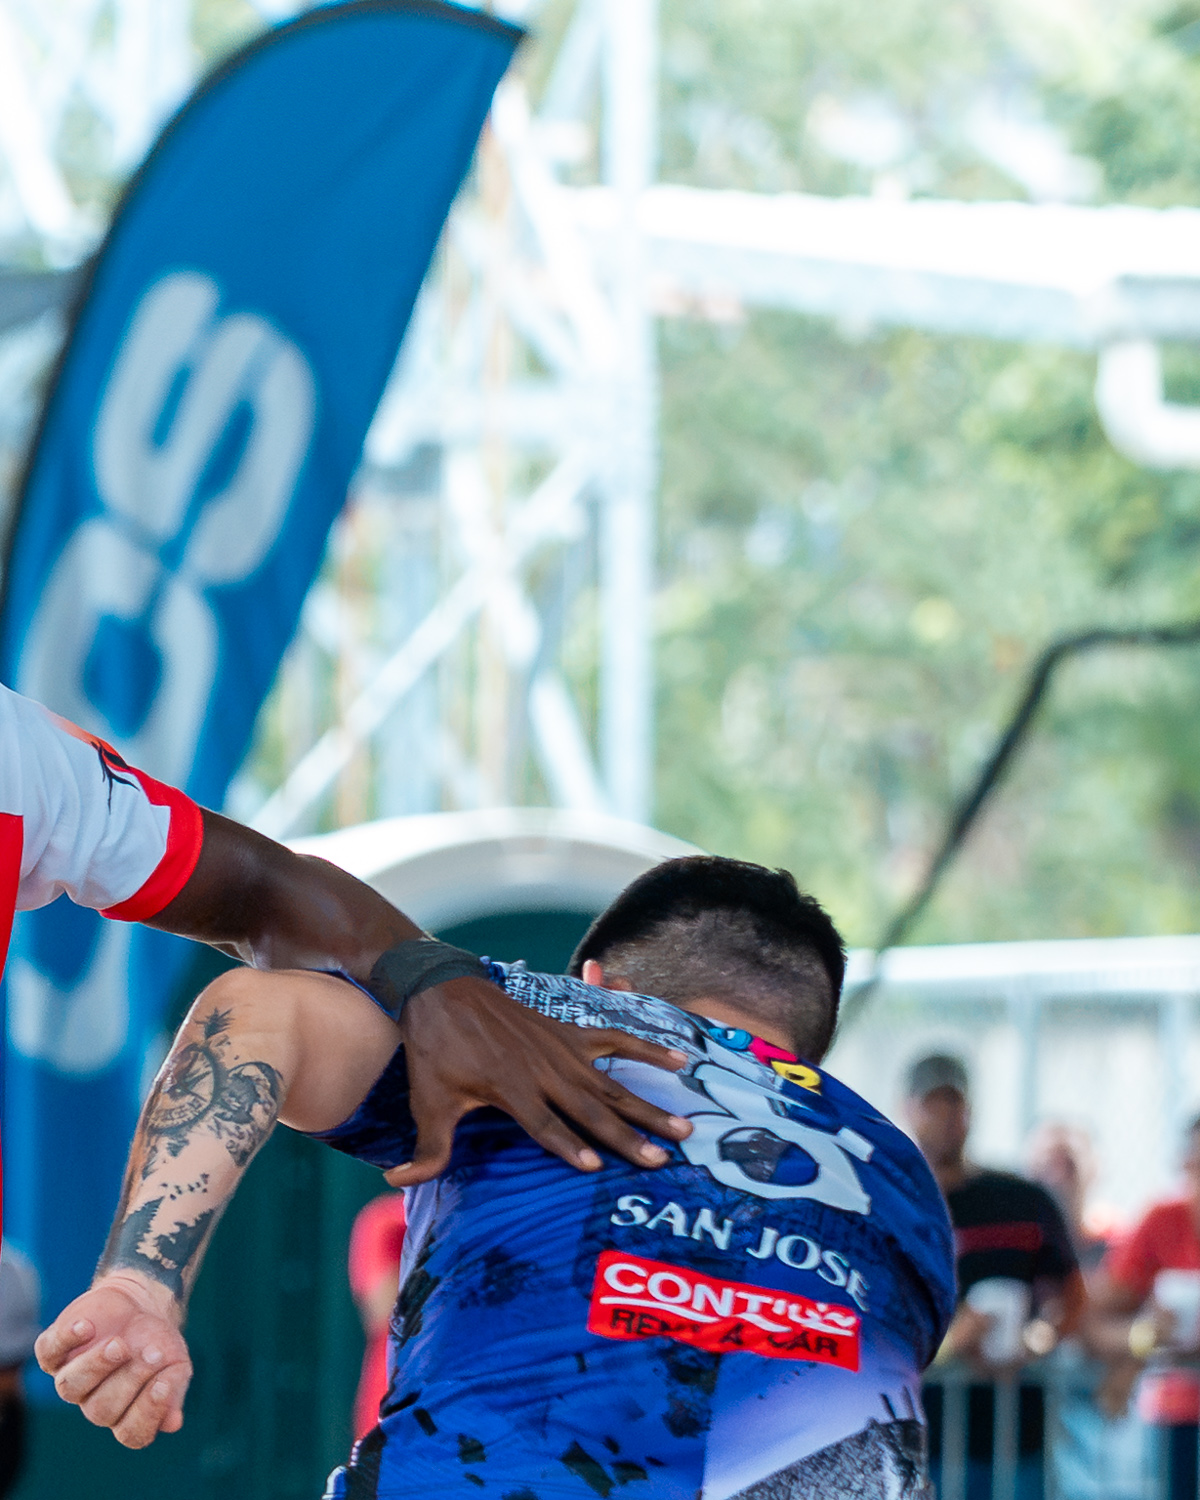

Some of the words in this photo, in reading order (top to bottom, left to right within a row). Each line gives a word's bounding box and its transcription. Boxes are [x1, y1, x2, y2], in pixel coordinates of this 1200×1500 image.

[610, 1194, 734, 1251] SAN
[746, 1226, 871, 1312] JOSE
[719, 1322, 744, 1346] A
